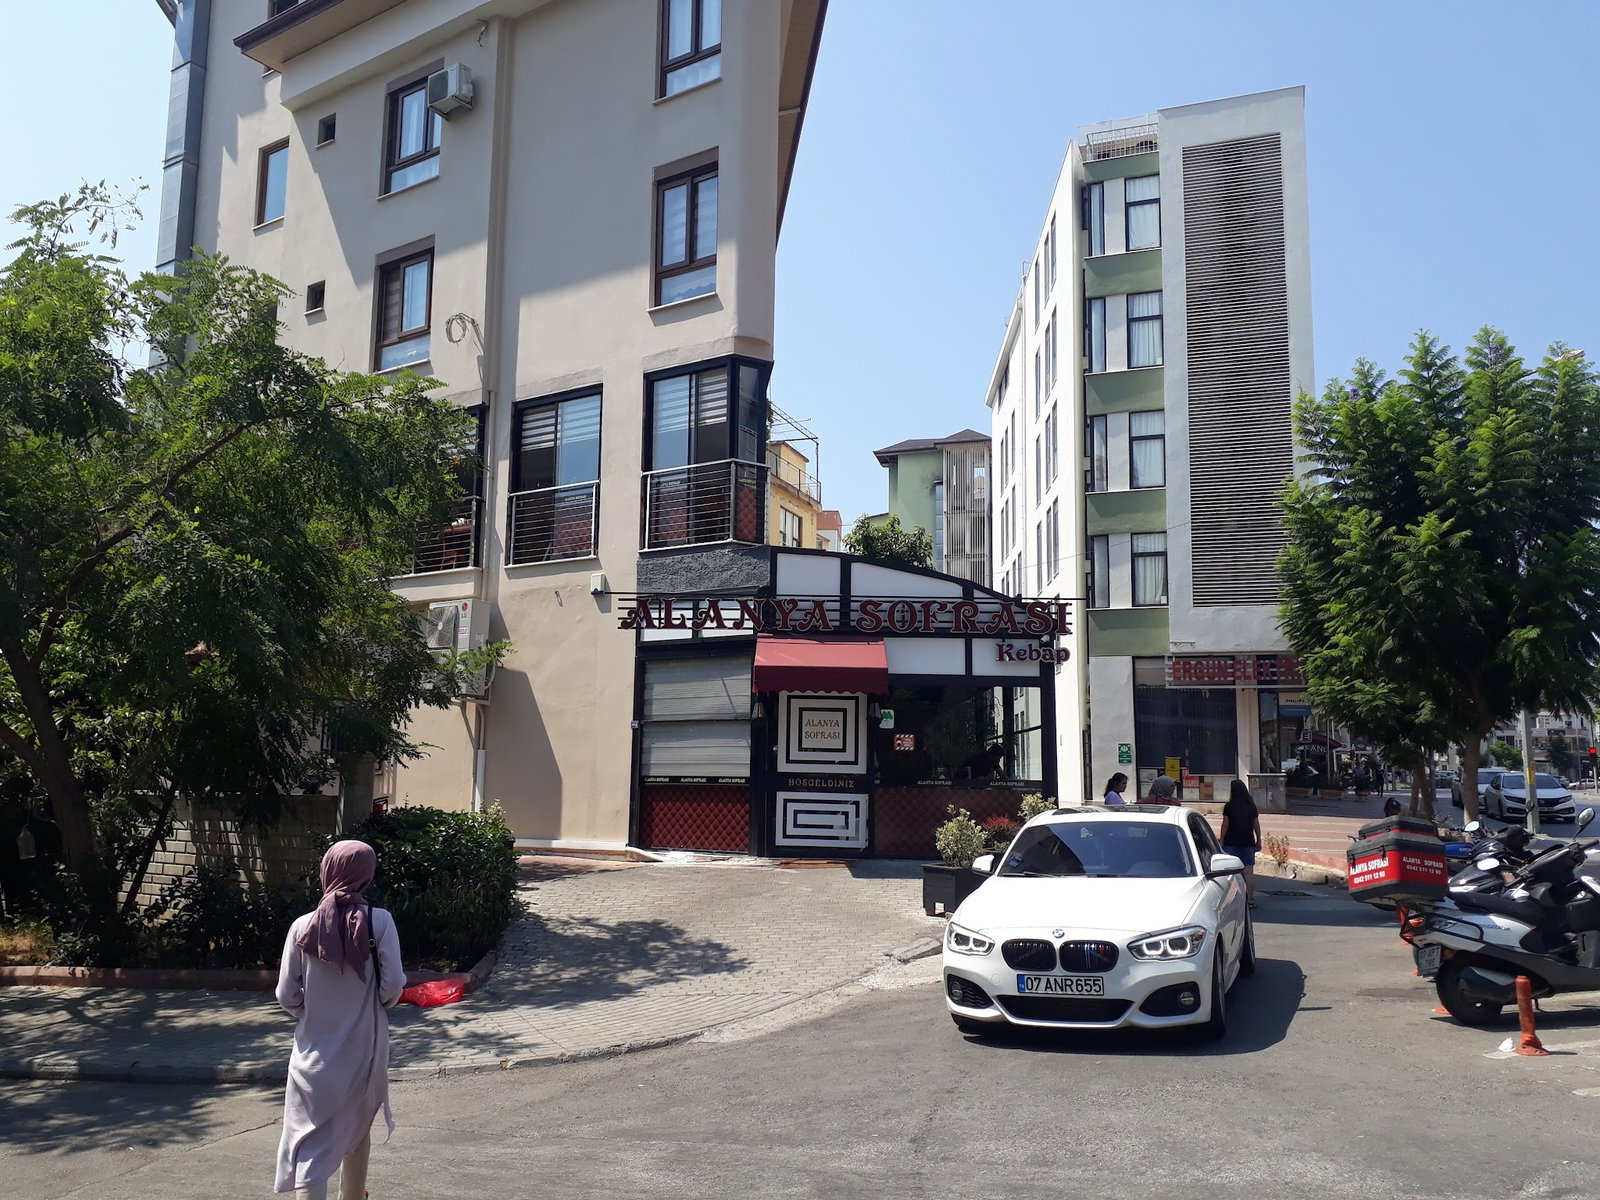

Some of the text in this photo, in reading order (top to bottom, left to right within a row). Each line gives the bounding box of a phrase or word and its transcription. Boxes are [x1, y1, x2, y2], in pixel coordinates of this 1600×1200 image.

[620, 598, 1071, 635] ALANYA SOFRASI
[996, 642, 1071, 665] Kebap
[804, 719, 841, 728] ALANYA
[804, 731, 841, 740] SOFRASI
[1368, 857, 1389, 871] SOFRASI
[1402, 856, 1421, 865] ALANYA
[1025, 976, 1042, 991] 07
[1044, 977, 1074, 992] ANR
[1075, 978, 1102, 993] 655
